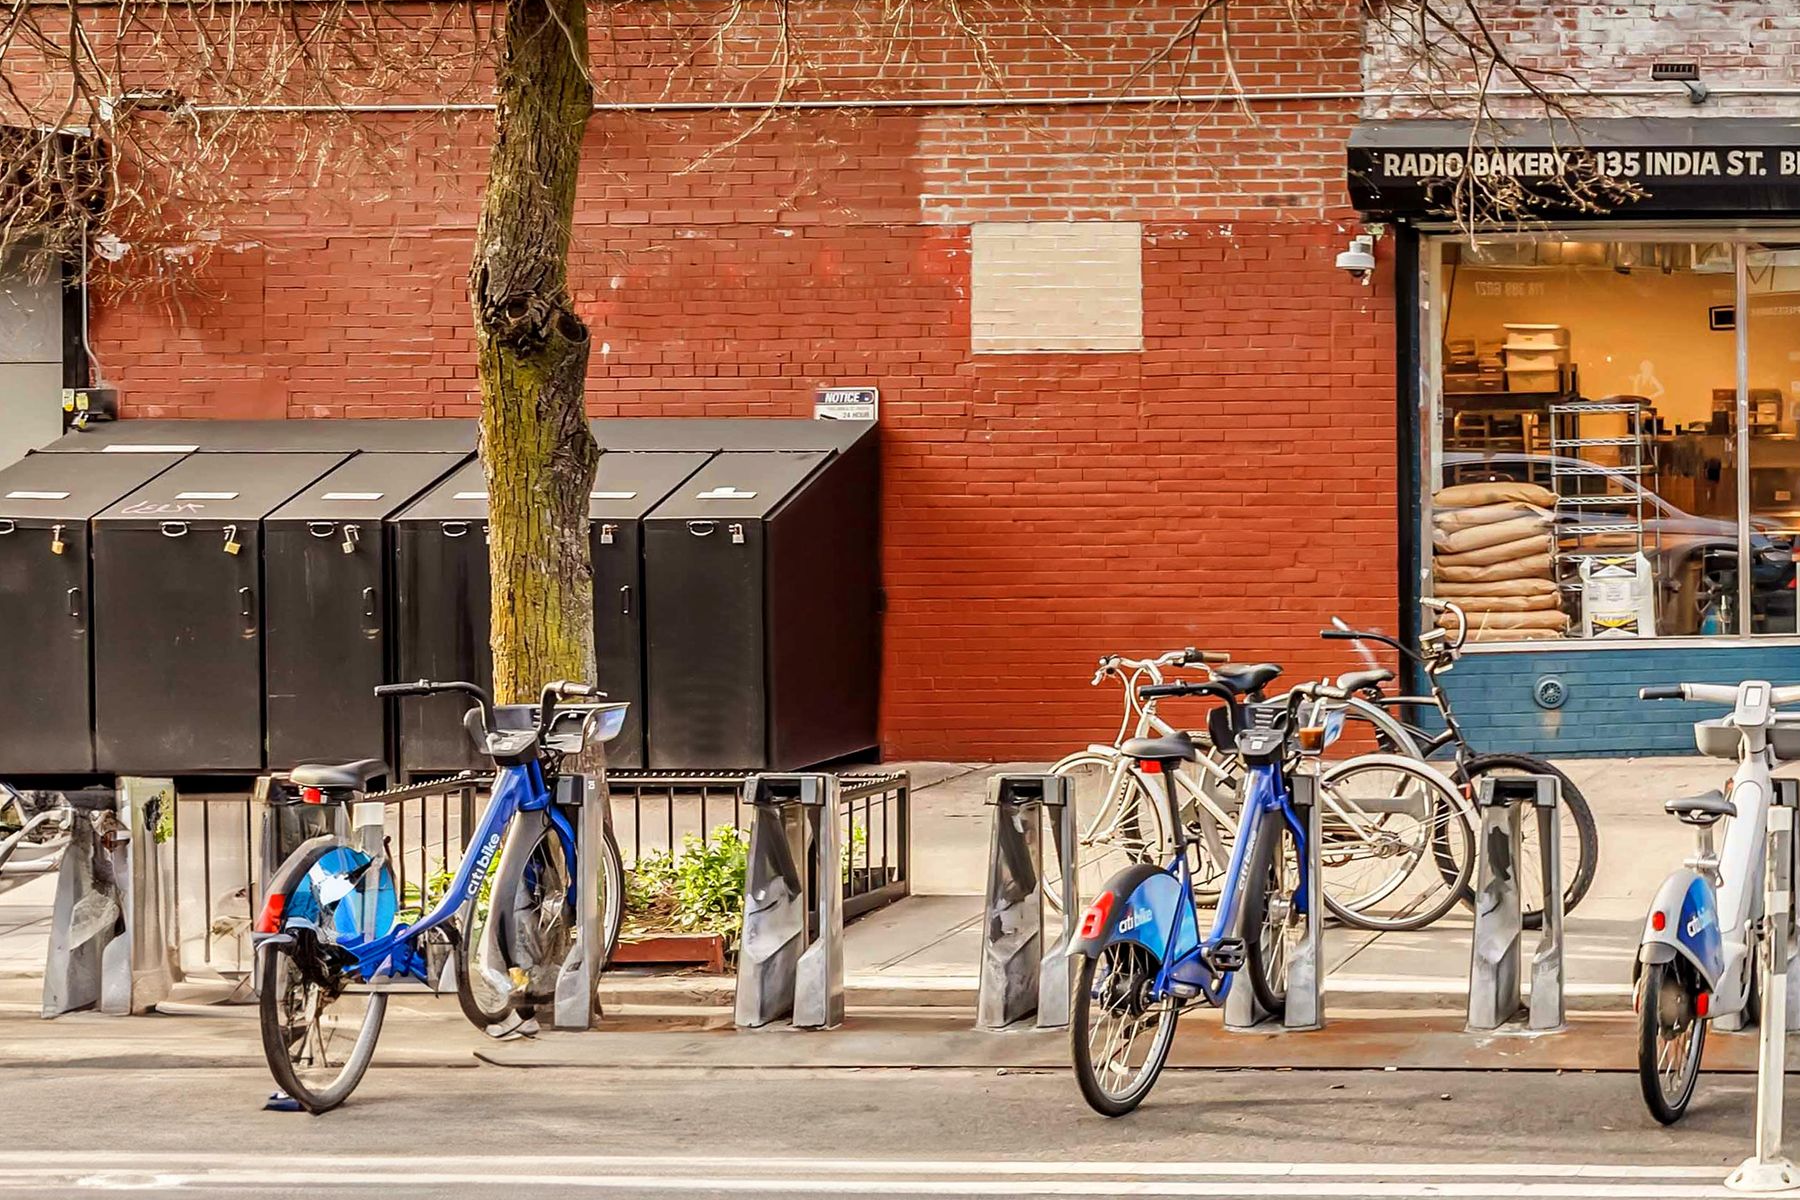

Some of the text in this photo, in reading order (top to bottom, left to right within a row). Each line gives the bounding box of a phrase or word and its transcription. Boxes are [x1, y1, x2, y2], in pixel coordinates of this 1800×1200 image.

[1383, 152, 1464, 178] RADIO
[1473, 151, 1571, 178] BAKERY
[1597, 151, 1640, 177] 135
[1645, 151, 1721, 176] INDIA
[1726, 150, 1767, 176] ST.
[825, 392, 860, 403] NOTICE
[476, 833, 500, 869] bike
